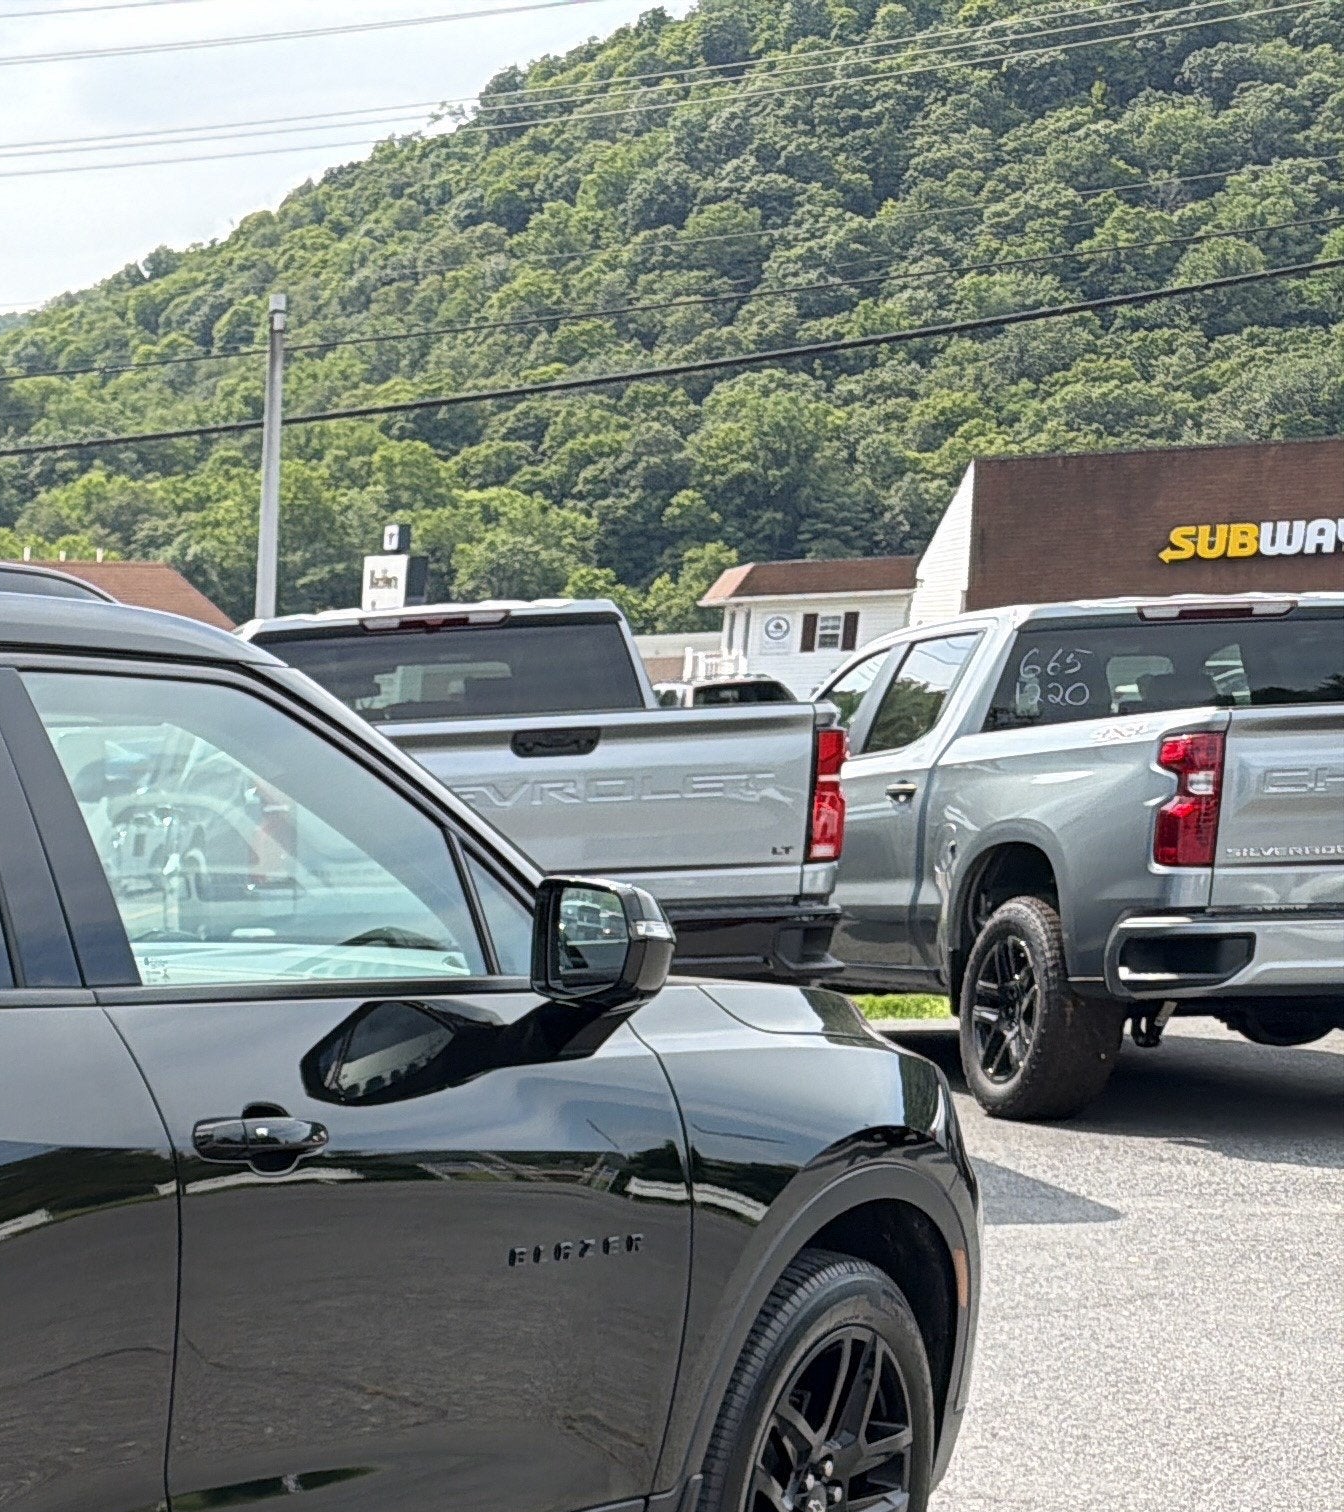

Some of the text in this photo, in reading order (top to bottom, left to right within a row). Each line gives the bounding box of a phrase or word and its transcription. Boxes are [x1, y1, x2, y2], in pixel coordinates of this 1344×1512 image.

[1020, 646, 1093, 679] 665
[1015, 681, 1090, 706] 1220
[508, 1232, 644, 1267] BLAZER
